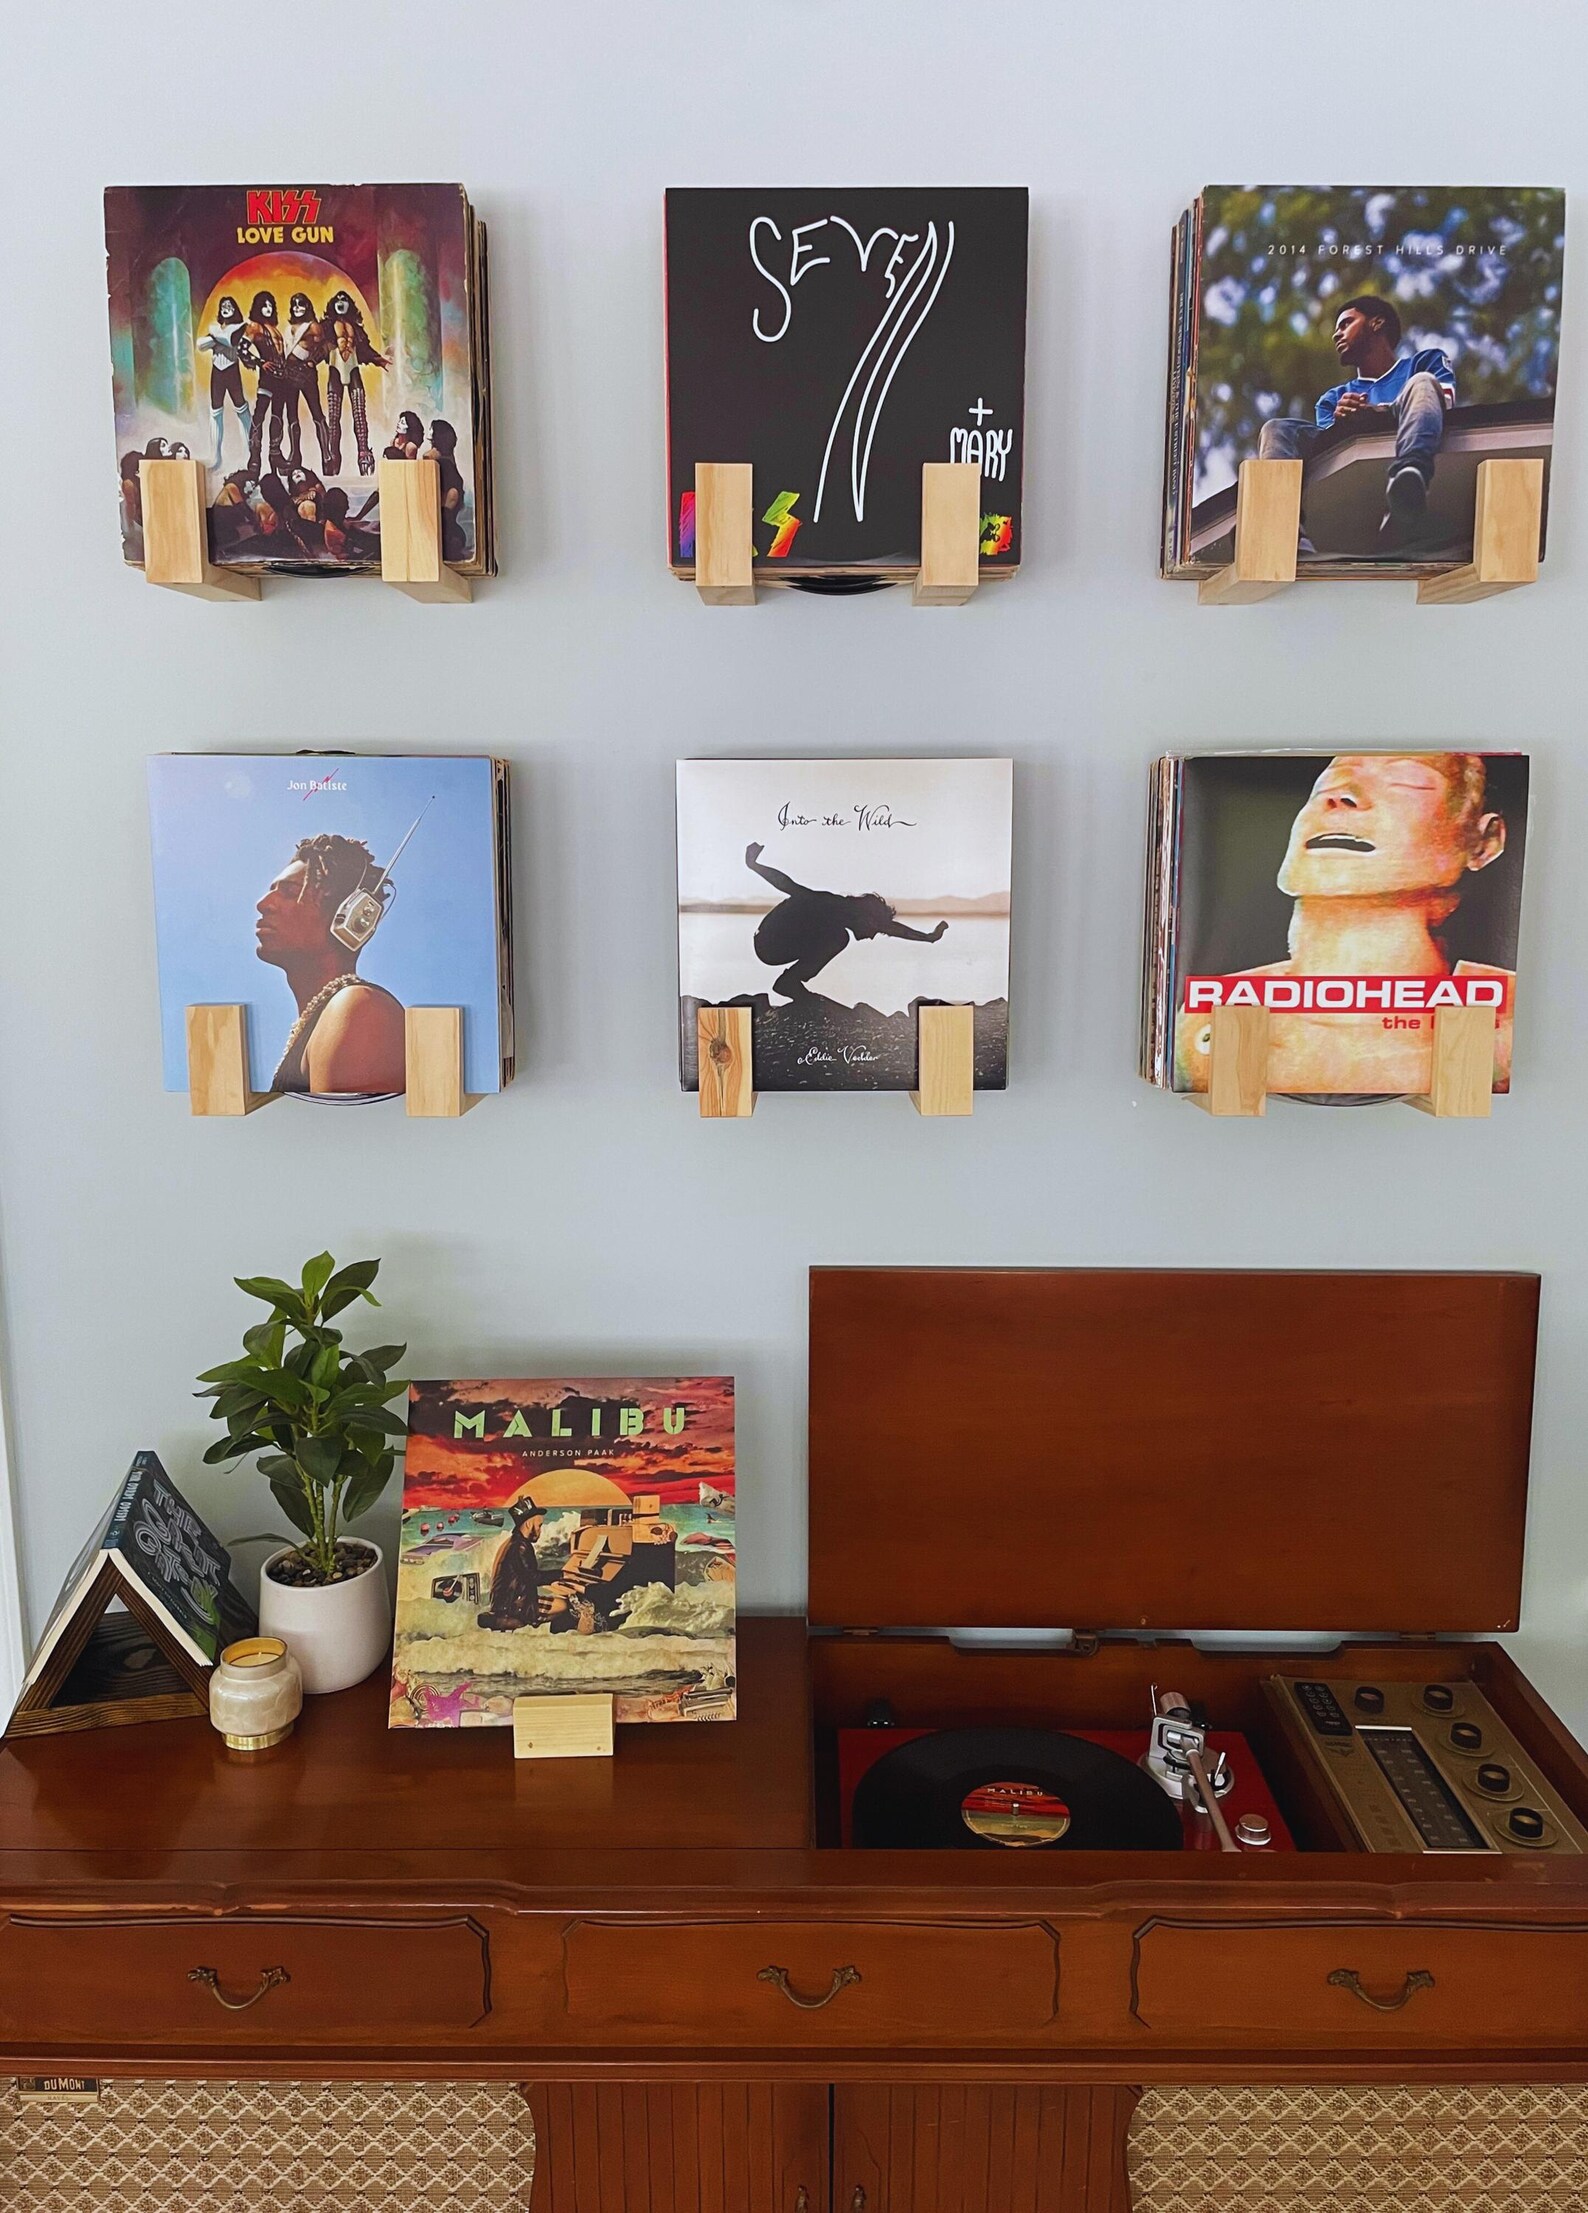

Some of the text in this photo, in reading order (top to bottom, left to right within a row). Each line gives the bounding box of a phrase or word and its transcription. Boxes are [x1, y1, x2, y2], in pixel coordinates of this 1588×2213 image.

[246, 189, 322, 225] KISS
[236, 226, 334, 244] LOVE GUN
[1267, 244, 1508, 256] 2014 FOREST HILLS DRIVE
[749, 214, 955, 523] SEVEN
[950, 427, 1013, 482] MARY
[287, 779, 348, 791] Jon Batiste
[778, 801, 917, 831] Into the Wild
[1188, 980, 1504, 1009] RADIOHEAD
[1382, 1015, 1422, 1029] the
[797, 1044, 882, 1066] Eddie Vedder
[453, 1407, 686, 1439] MALIBU
[522, 1449, 582, 1457] ANDERSON
[987, 1787, 1044, 1797] MALIBU
